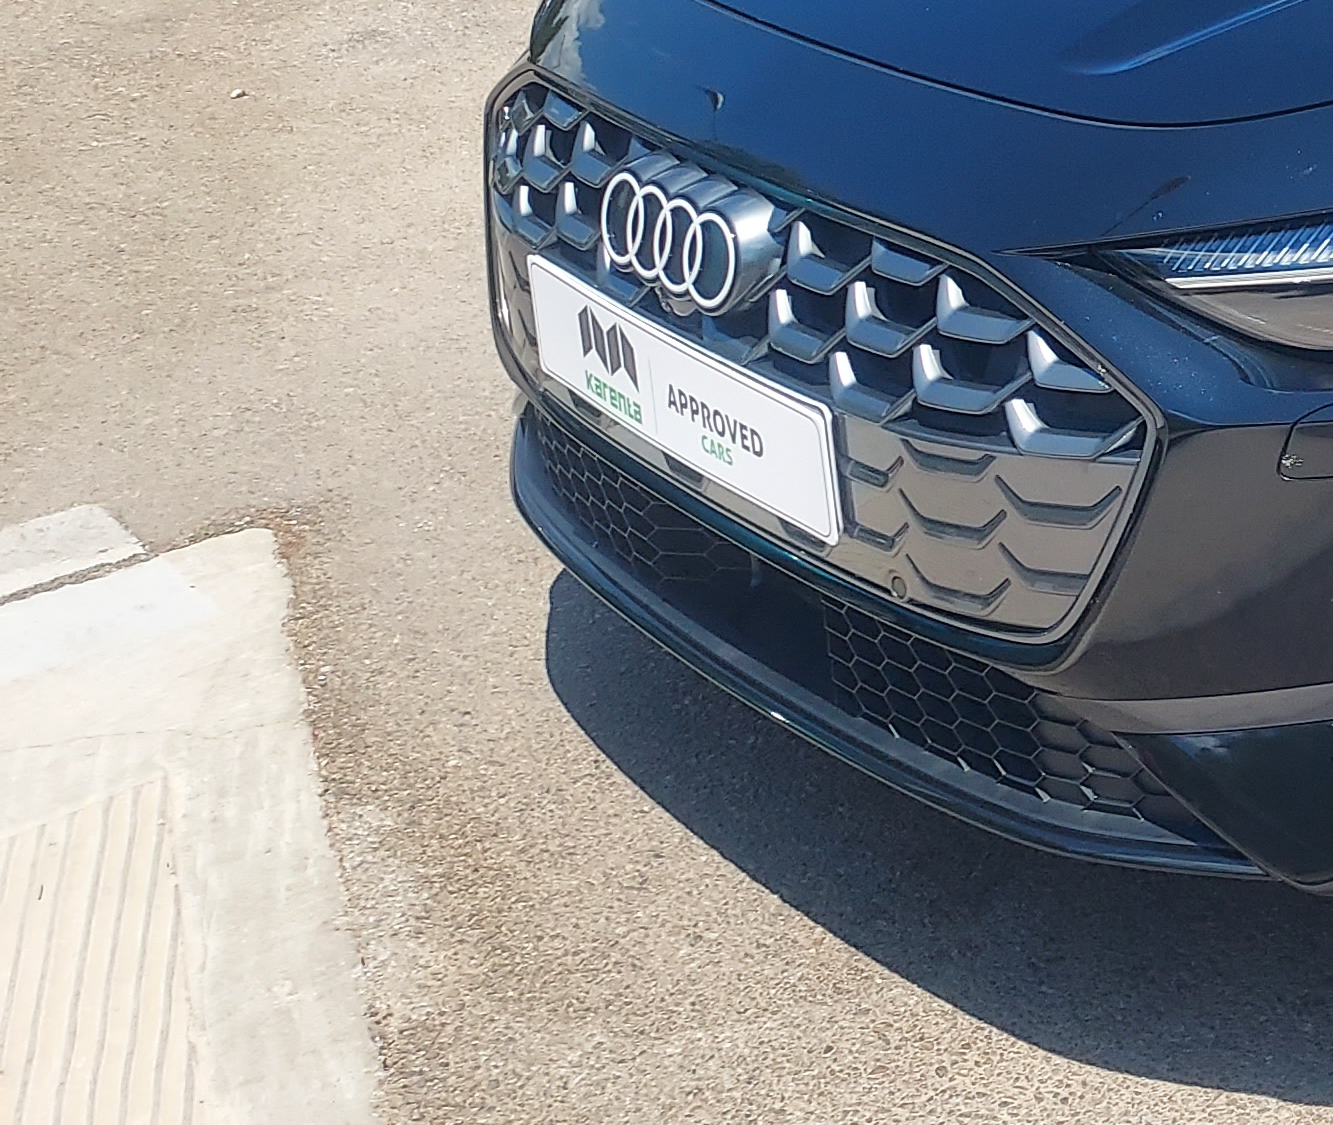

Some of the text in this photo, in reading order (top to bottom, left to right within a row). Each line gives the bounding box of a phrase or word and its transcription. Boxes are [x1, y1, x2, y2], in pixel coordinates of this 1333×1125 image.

[585, 369, 643, 425] karenta
[668, 383, 764, 458] APPROVED
[701, 434, 734, 466] CARS
